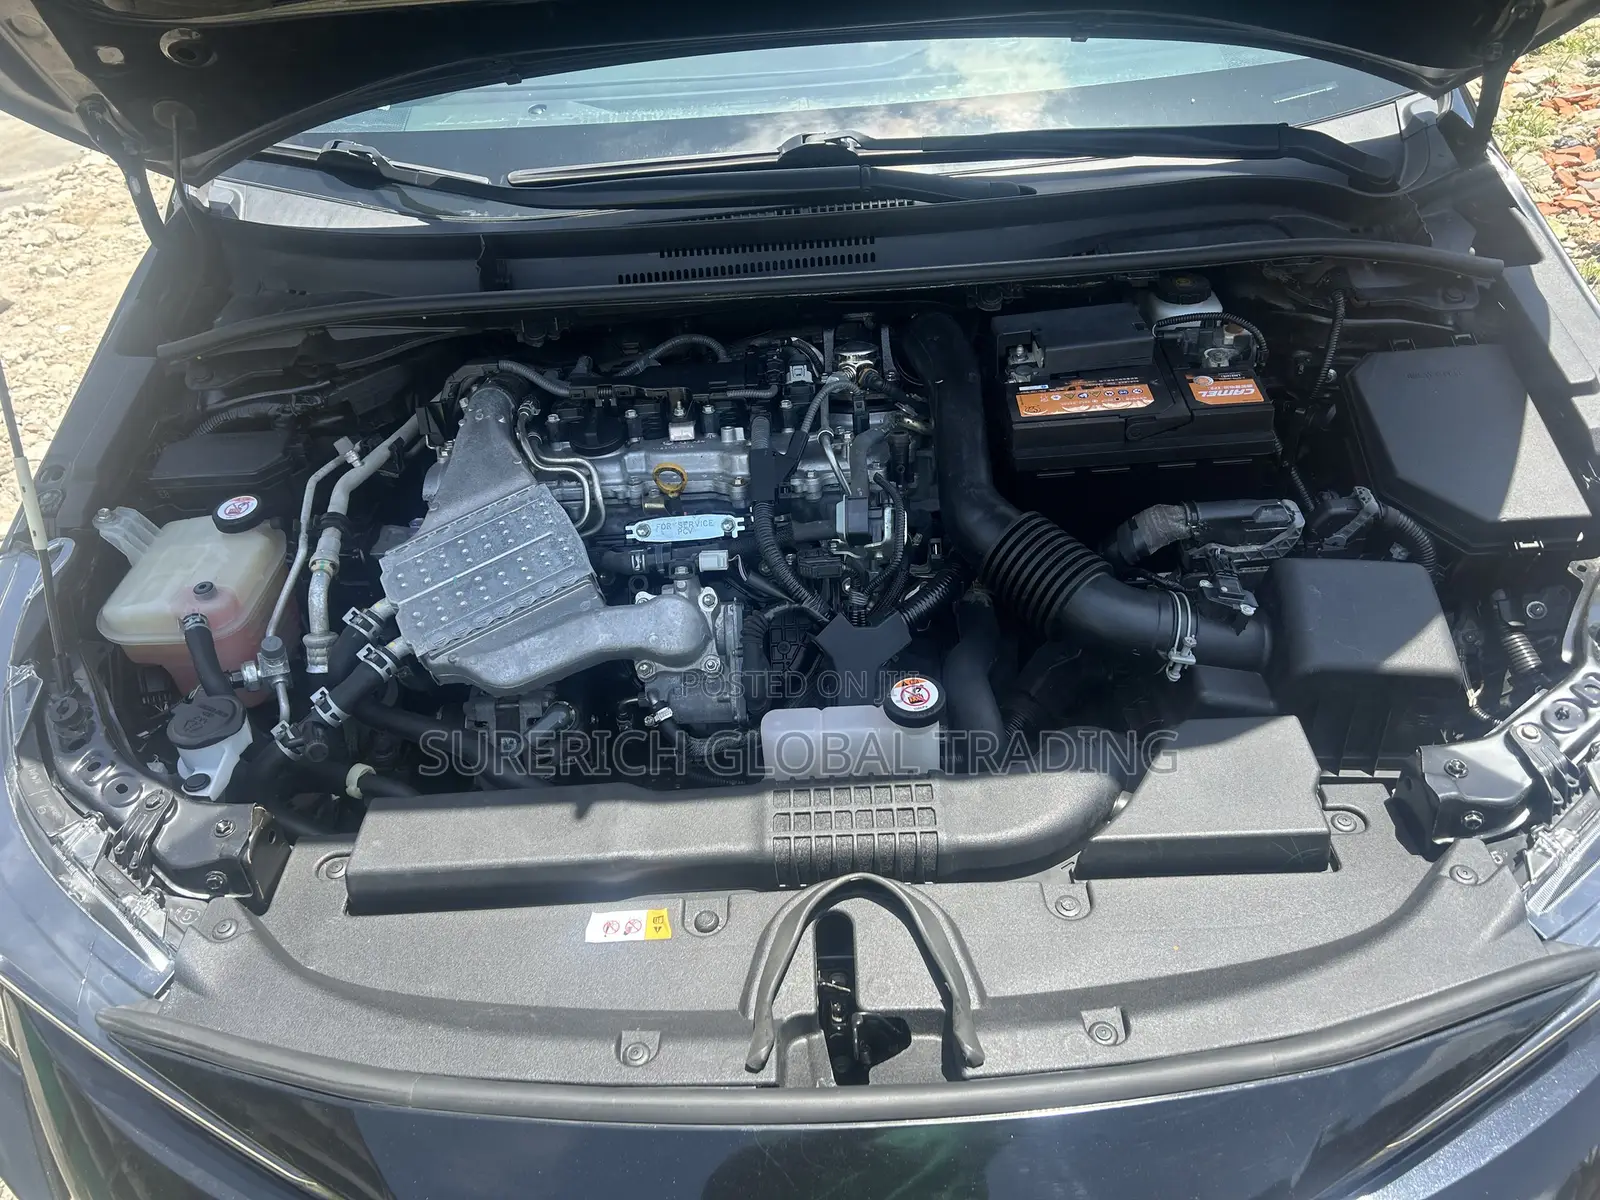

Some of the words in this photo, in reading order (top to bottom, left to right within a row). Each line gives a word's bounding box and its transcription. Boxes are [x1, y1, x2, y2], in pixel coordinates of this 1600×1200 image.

[1198, 388, 1256, 398] CAMEL
[656, 522, 672, 532] FOR
[677, 519, 714, 530] SERVICE
[677, 528, 694, 536] PCV
